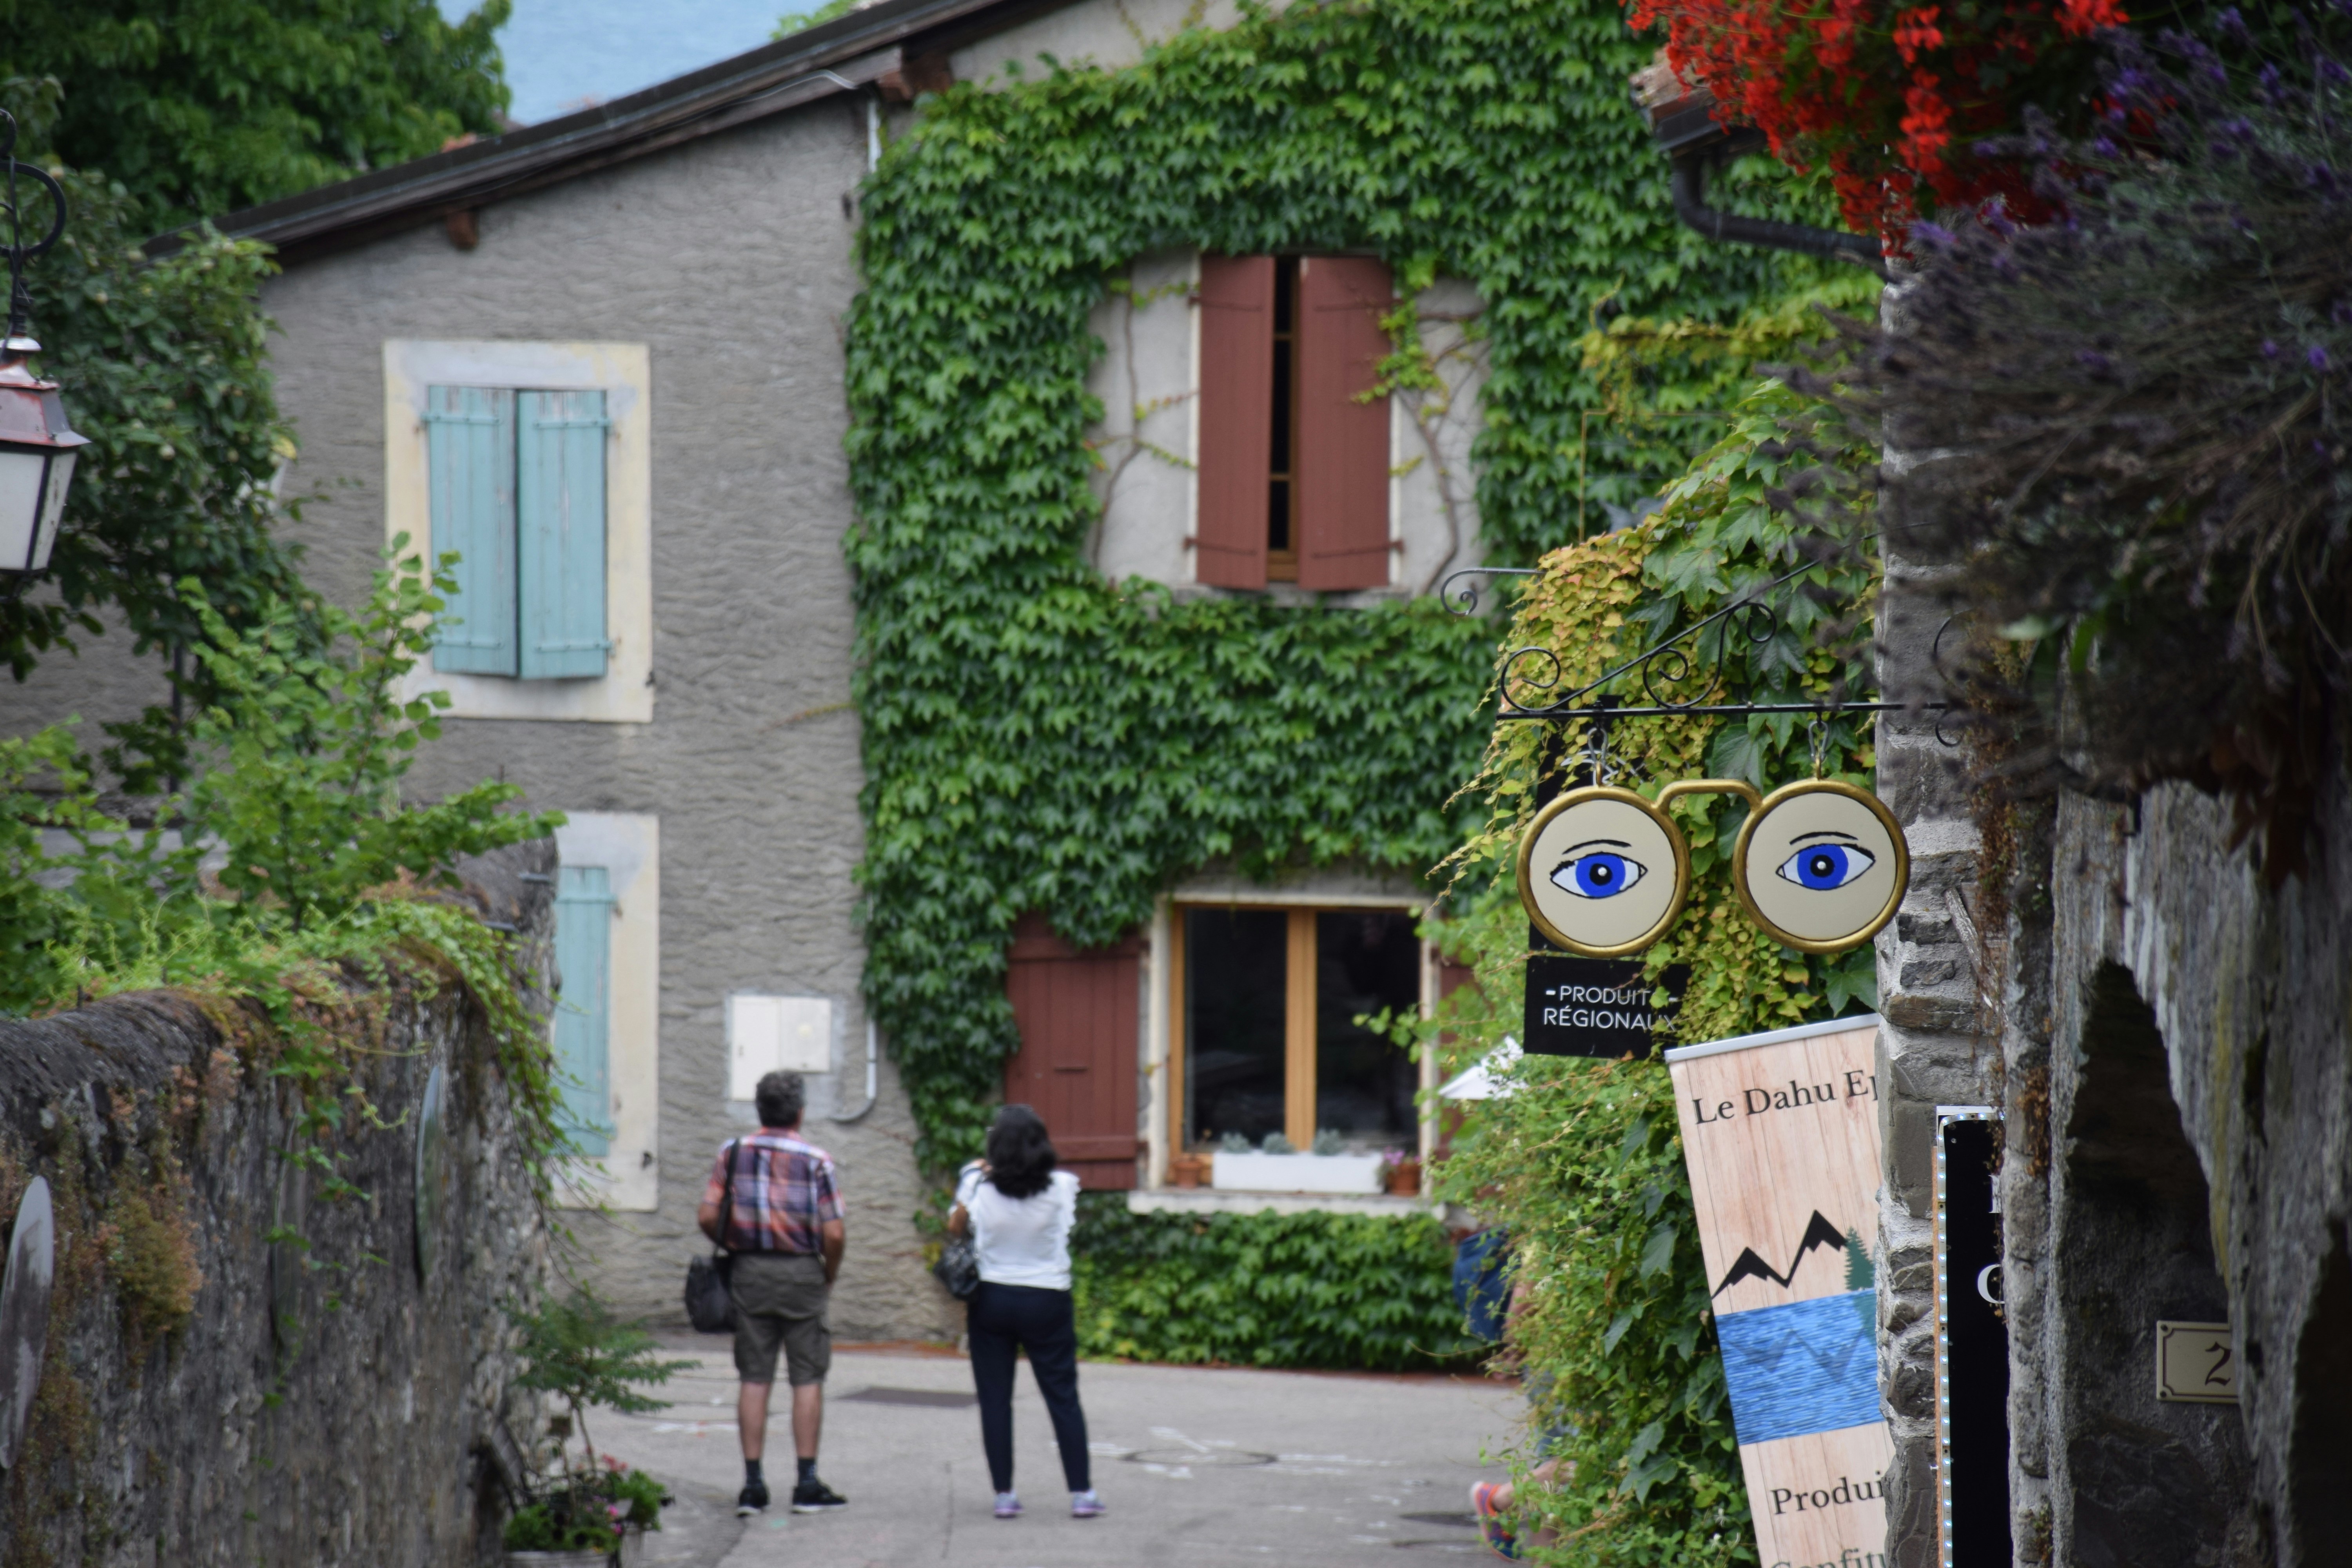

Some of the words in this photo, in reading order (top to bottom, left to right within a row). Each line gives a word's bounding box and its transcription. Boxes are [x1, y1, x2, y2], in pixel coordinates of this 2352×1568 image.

[1544, 1005, 1679, 1031] RÉGIONAUX
[1692, 1098, 1735, 1124] Le
[1743, 1080, 1837, 1116] Dahu
